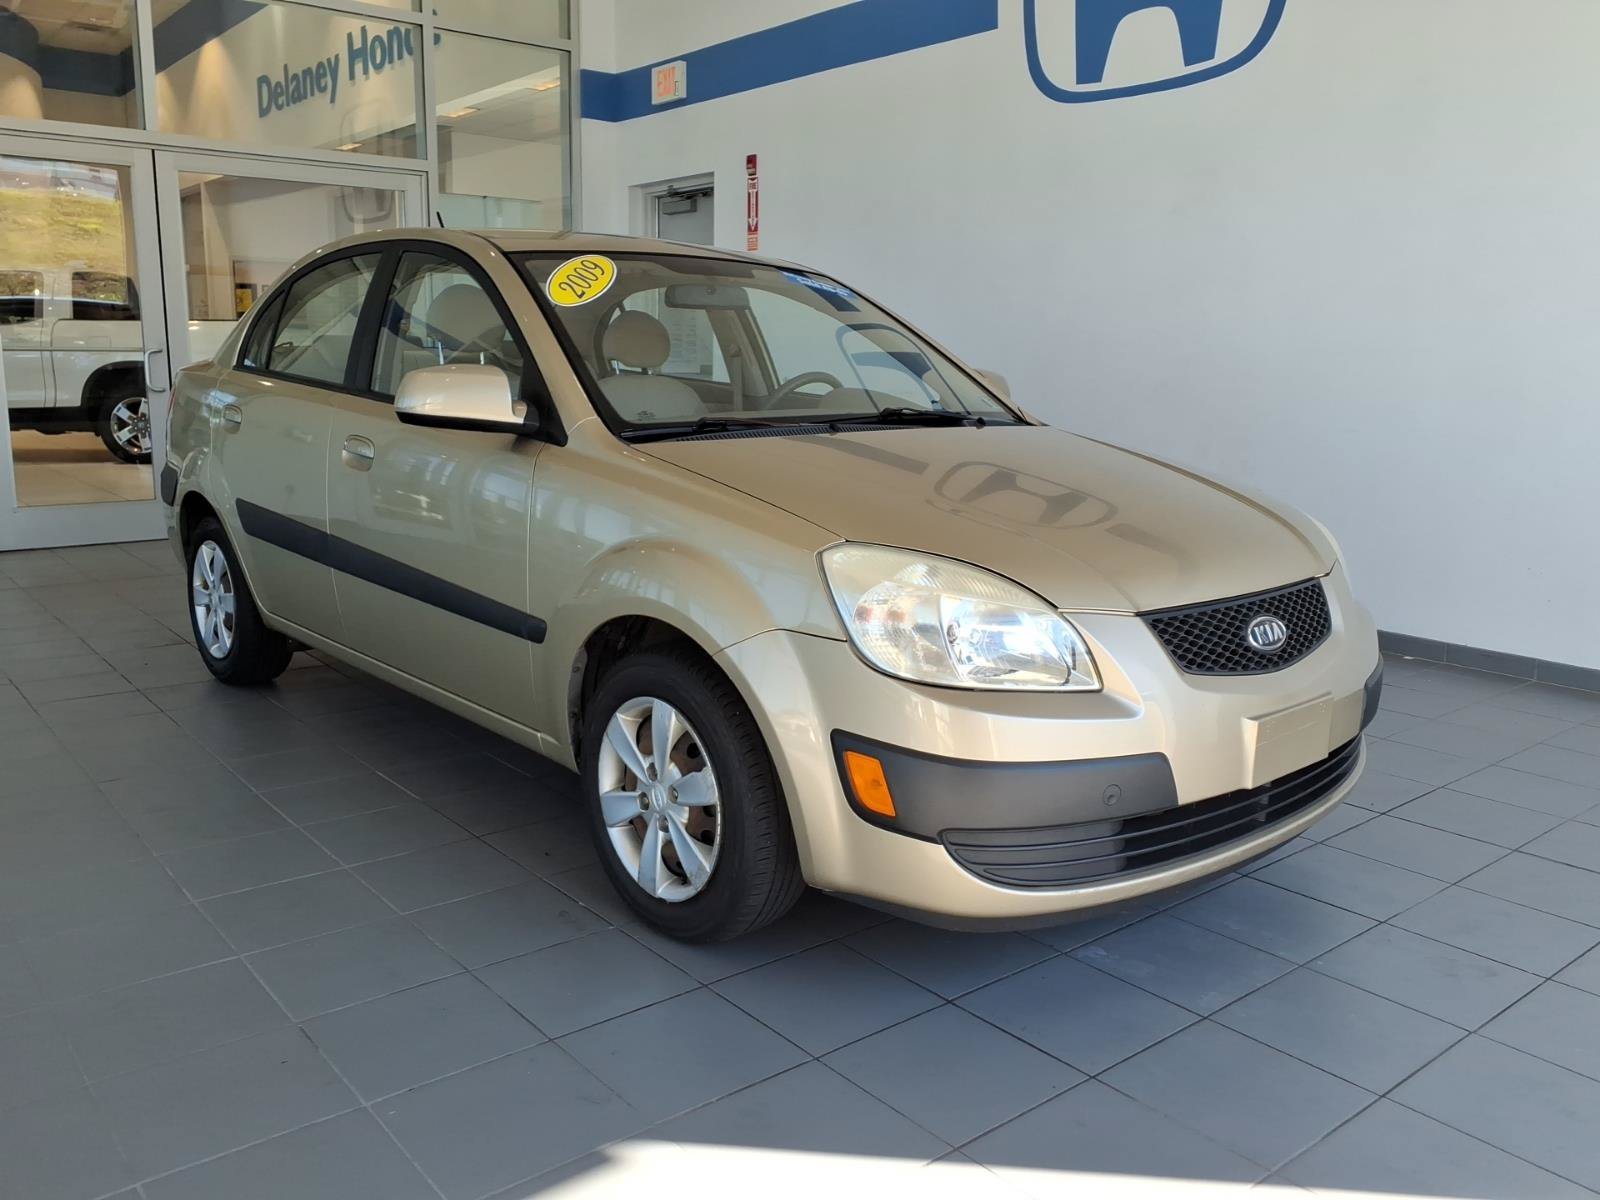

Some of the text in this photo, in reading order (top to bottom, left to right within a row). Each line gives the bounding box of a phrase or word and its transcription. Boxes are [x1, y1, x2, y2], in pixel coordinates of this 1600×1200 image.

[257, 24, 441, 118] Delaney Hon
[558, 259, 605, 299] 2009
[1254, 622, 1283, 645] KIA
